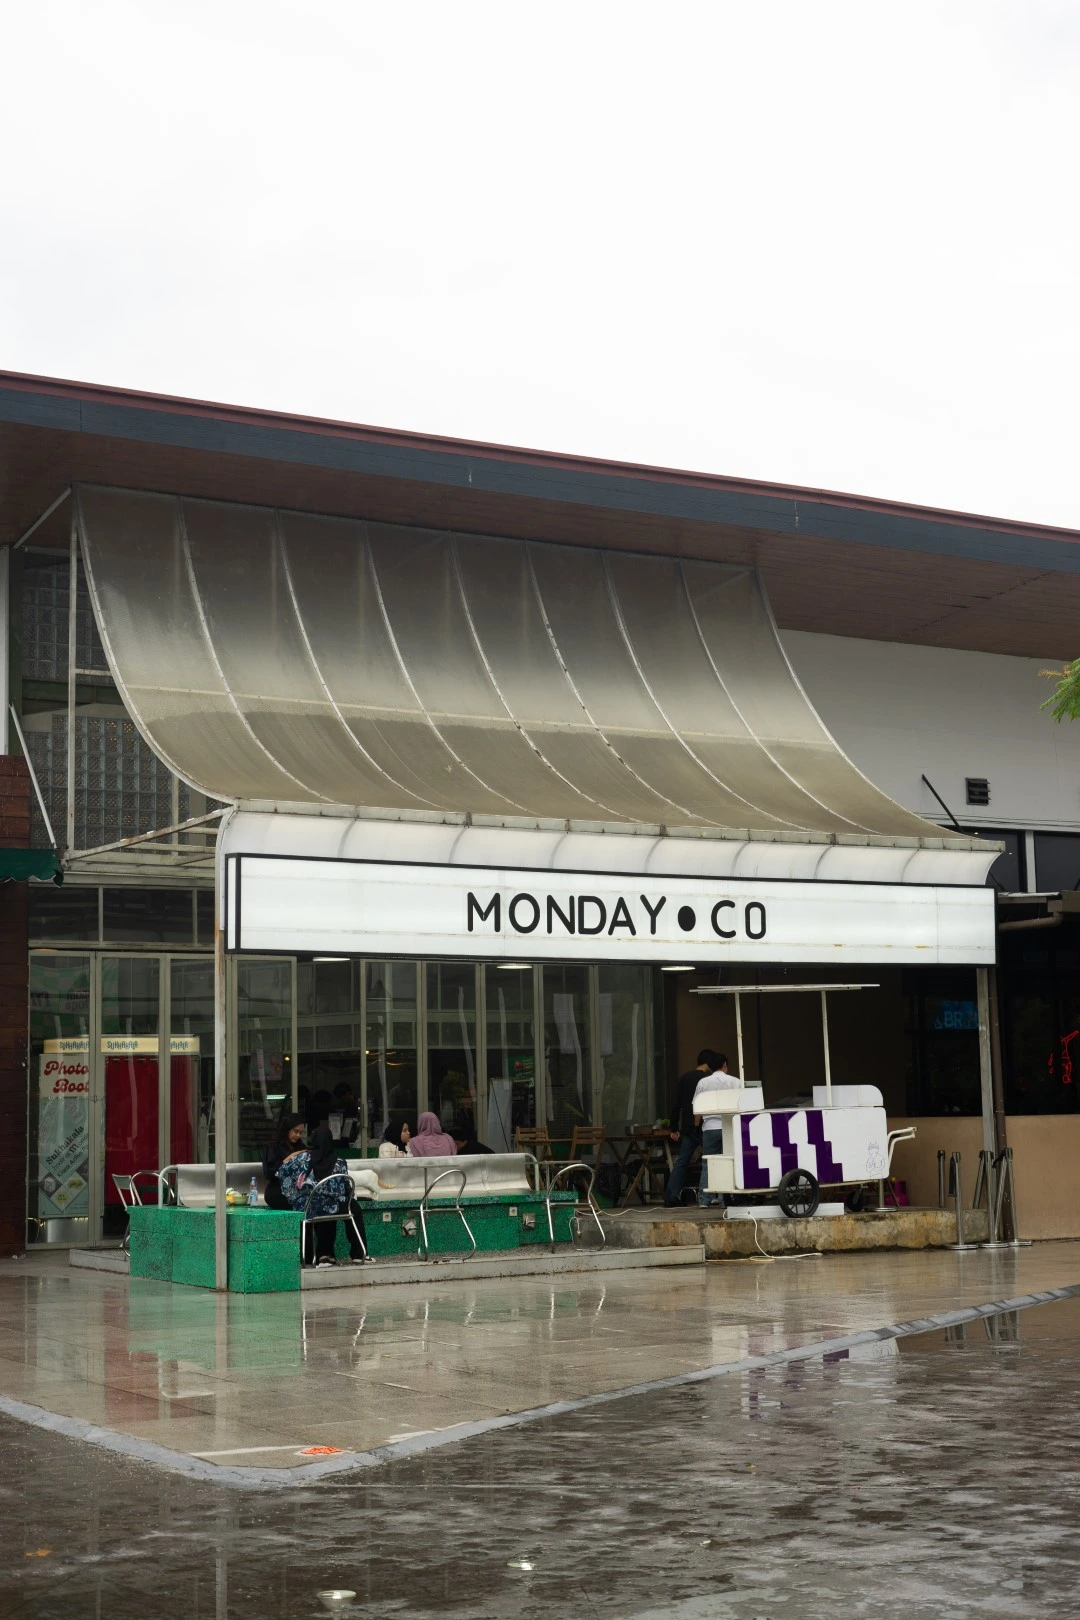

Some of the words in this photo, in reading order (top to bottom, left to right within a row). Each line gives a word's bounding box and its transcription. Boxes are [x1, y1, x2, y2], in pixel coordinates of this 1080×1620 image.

[467, 891, 667, 936] MONDAY
[710, 899, 767, 940] CO
[44, 1060, 89, 1076] Photo
[53, 1078, 90, 1094] Boot
[46, 1126, 84, 1165] Sukhakala
